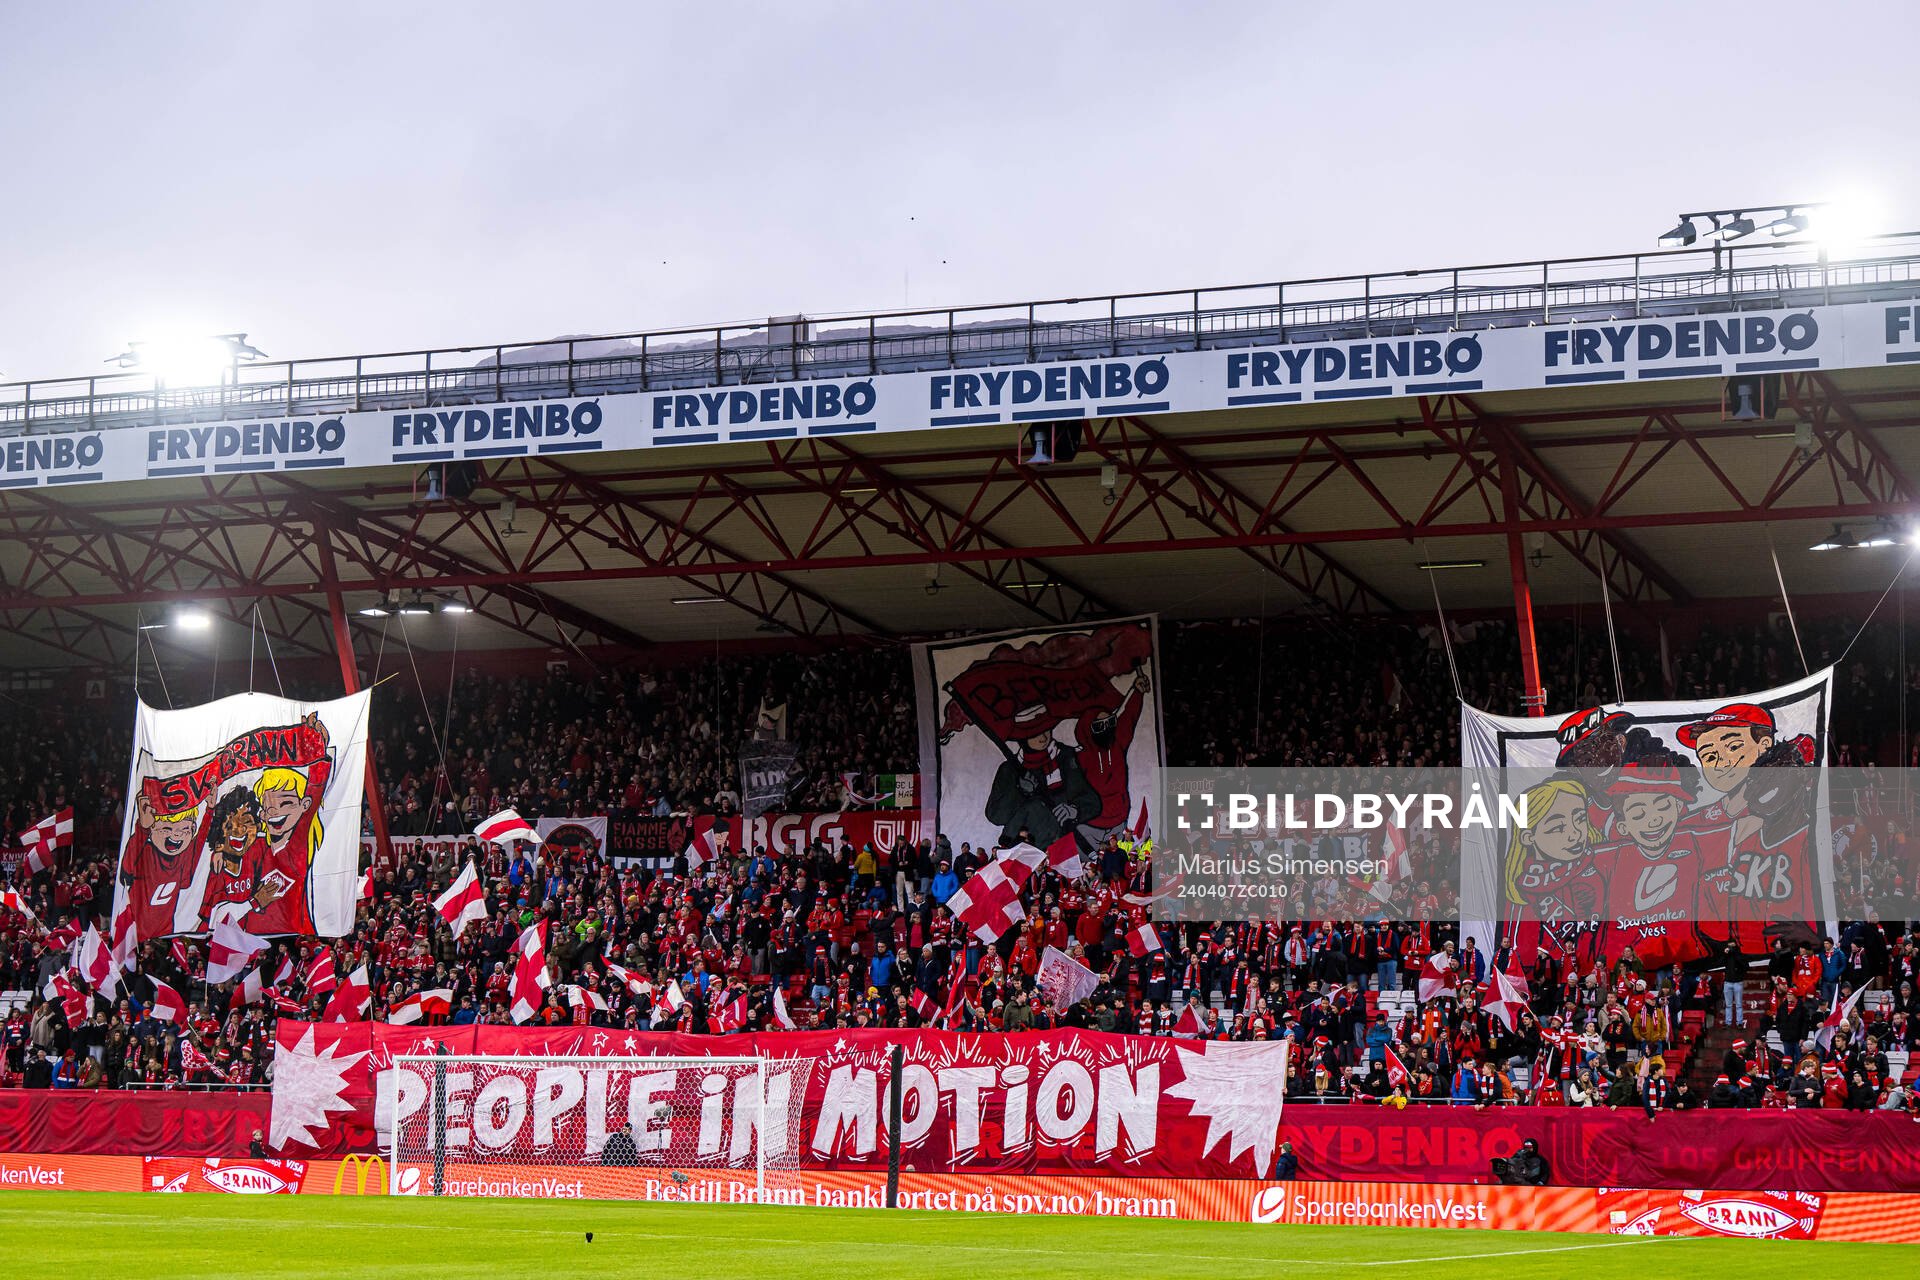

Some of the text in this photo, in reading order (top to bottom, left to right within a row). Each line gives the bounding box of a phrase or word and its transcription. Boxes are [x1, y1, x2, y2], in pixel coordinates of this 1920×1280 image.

[1545, 308, 1819, 367] FRYDENBØ
[1227, 333, 1482, 388] FRYDENBØ
[931, 355, 1170, 409] FRYDENBØ
[393, 398, 603, 447] FRYDENBØ
[653, 378, 876, 429] FRYDENBØ
[0, 432, 103, 471] ENBØ
[148, 416, 345, 462] FRYDENBØ
[162, 731, 297, 810] SK BRANN
[613, 821, 667, 836] FIAMME
[613, 836, 667, 849] ROSSE
[742, 813, 844, 860] BGG
[226, 878, 251, 894] 1908
[1731, 854, 1792, 899] SKB
[1616, 908, 1686, 930] Sparebanken
[374, 1066, 677, 1154] PEOPLE
[1280, 1123, 1521, 1166] RYDENBØ
[1733, 1148, 1879, 1172] GRUPPEN
[223, 1173, 272, 1190] BRANN
[286, 1159, 304, 1174] VISA
[645, 1179, 721, 1203] Bestill
[965, 1186, 997, 1212] på
[1003, 1190, 1177, 1217] spv.no/brann
[1707, 1207, 1777, 1228] BRANN
[1795, 1191, 1820, 1209] VISA
